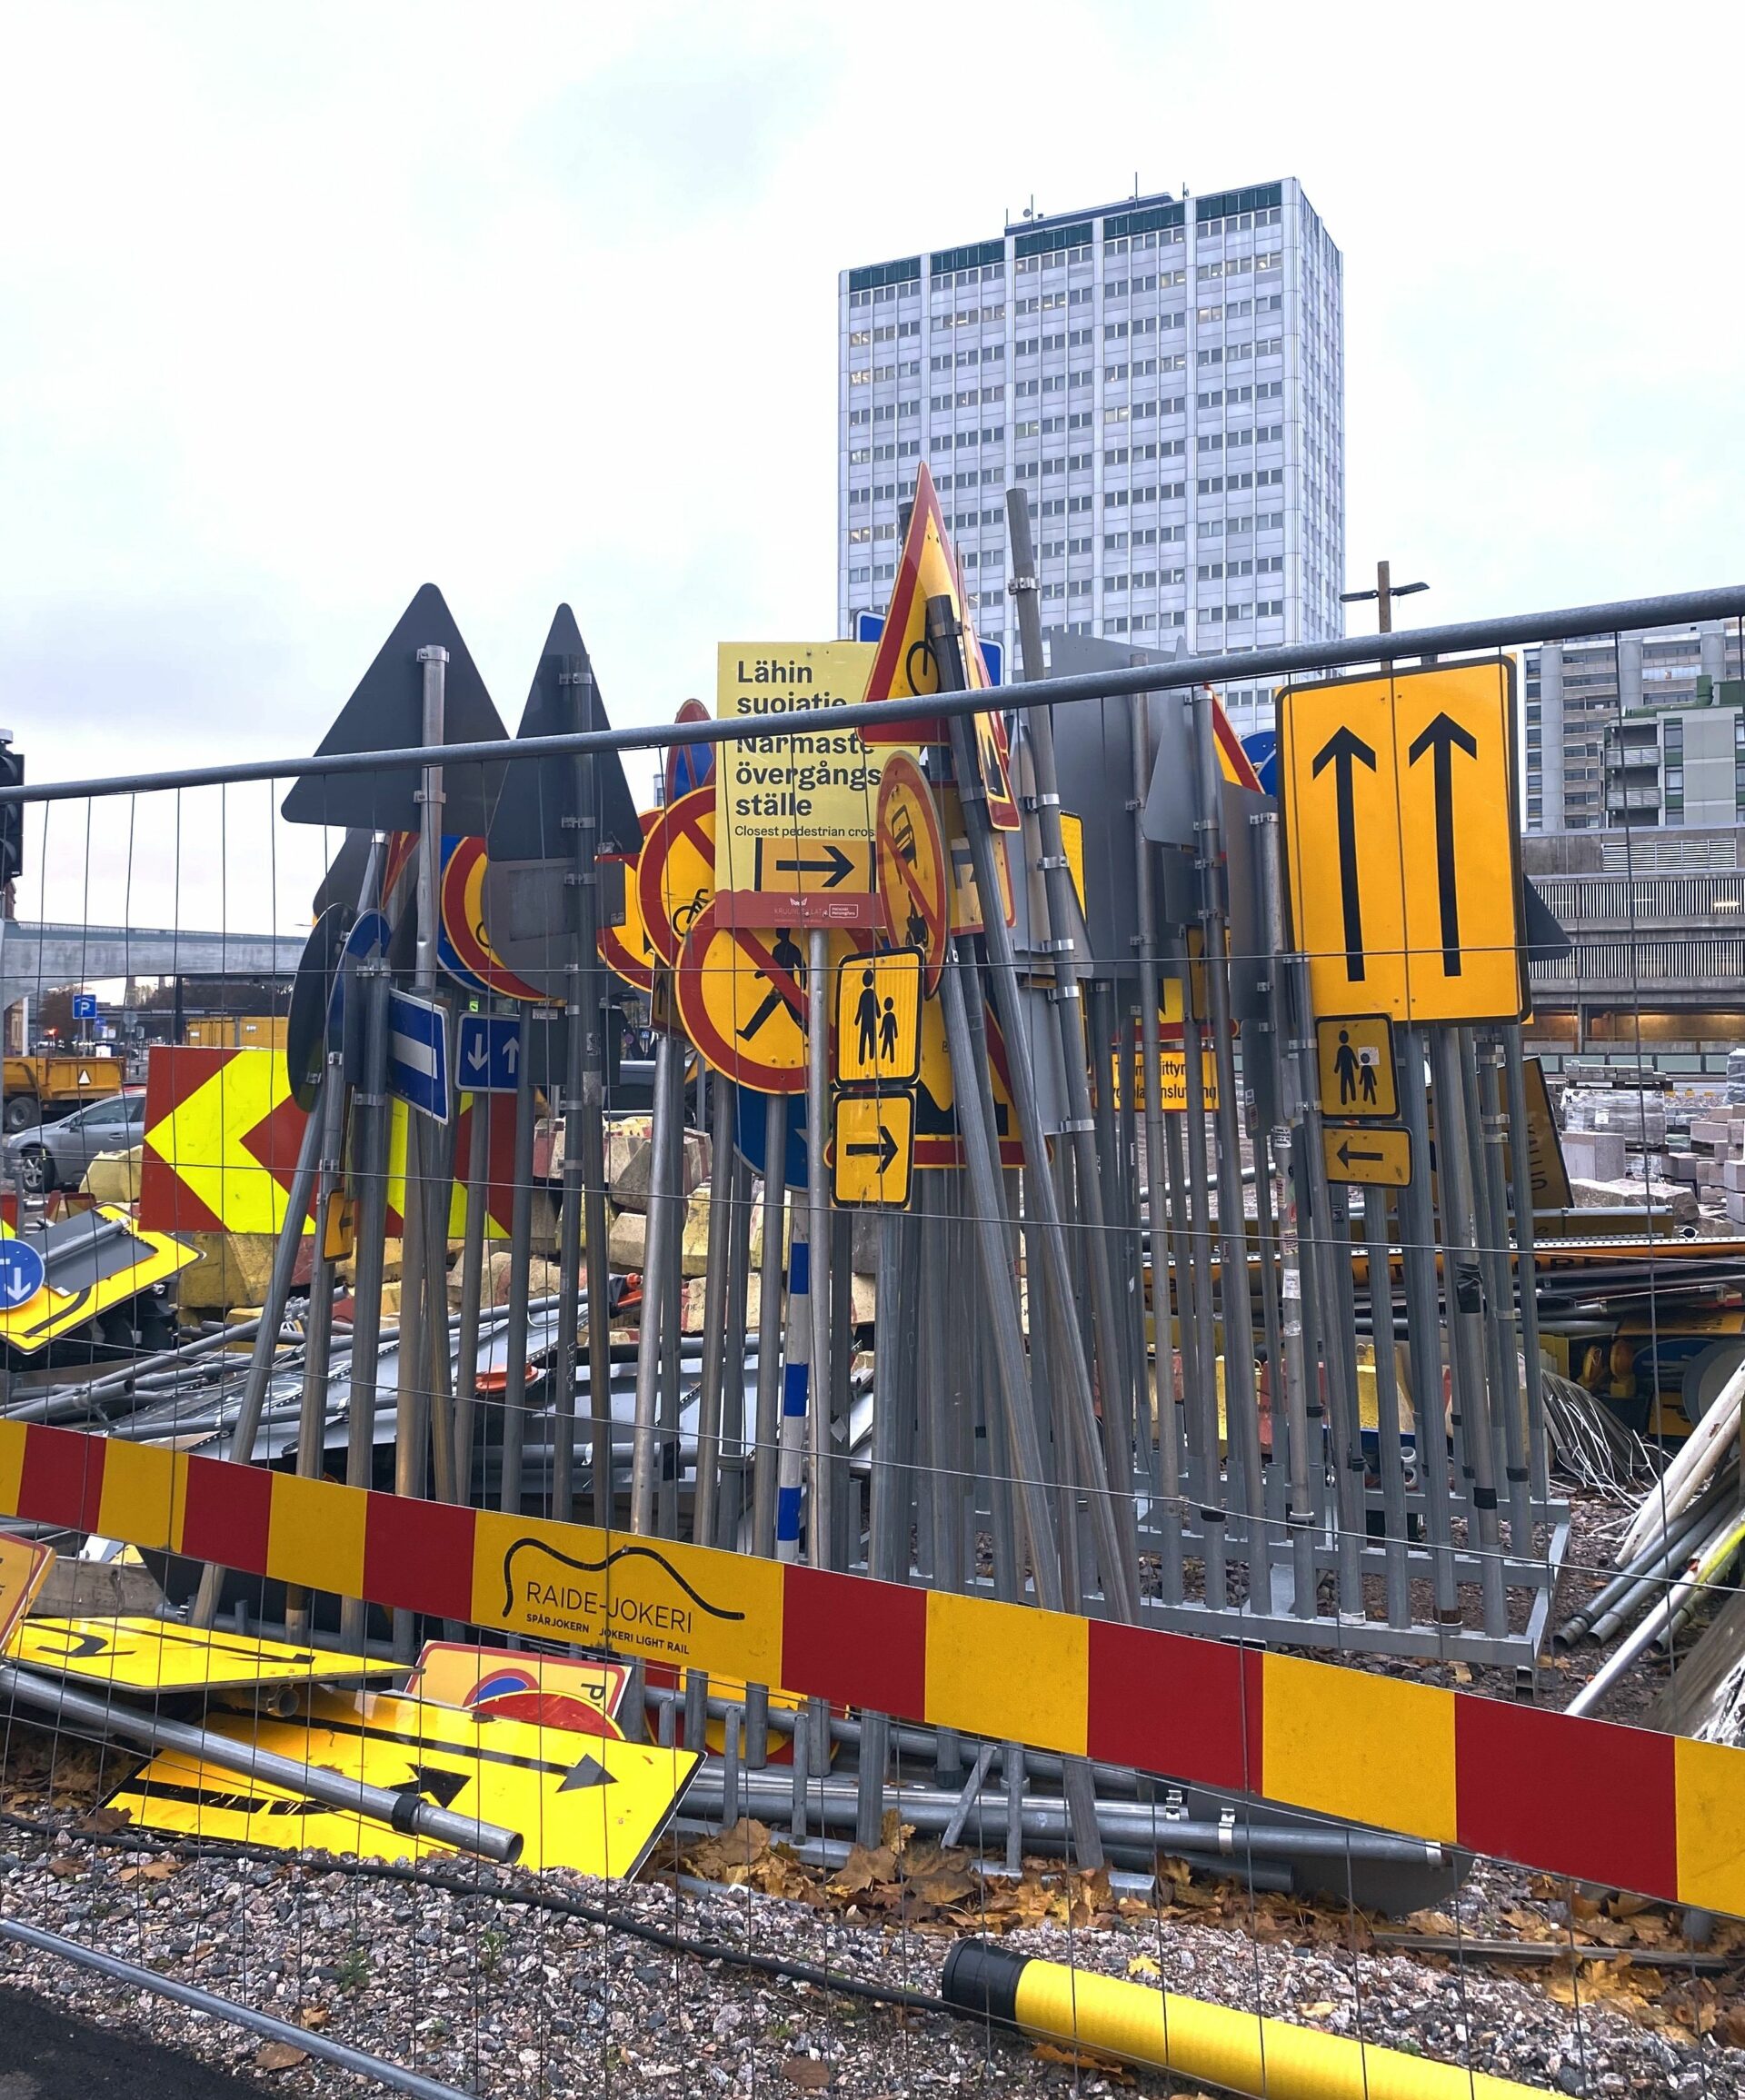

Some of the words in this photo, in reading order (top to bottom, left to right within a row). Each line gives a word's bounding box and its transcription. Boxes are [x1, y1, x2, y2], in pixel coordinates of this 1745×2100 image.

[738, 660, 813, 683] Lähin
[736, 760, 882, 791] övergångs
[735, 792, 812, 816] ställe
[734, 825, 780, 836] Closest
[782, 825, 845, 838] pedestrian
[80, 1001, 91, 1016] P
[526, 1581, 692, 1634] RAIDE-JOKERI
[526, 1612, 590, 1634] SPÅRJOKERN
[598, 1627, 633, 1643] JOKERI
[636, 1634, 665, 1649] LIGHT
[666, 1641, 690, 1656] RAIL
